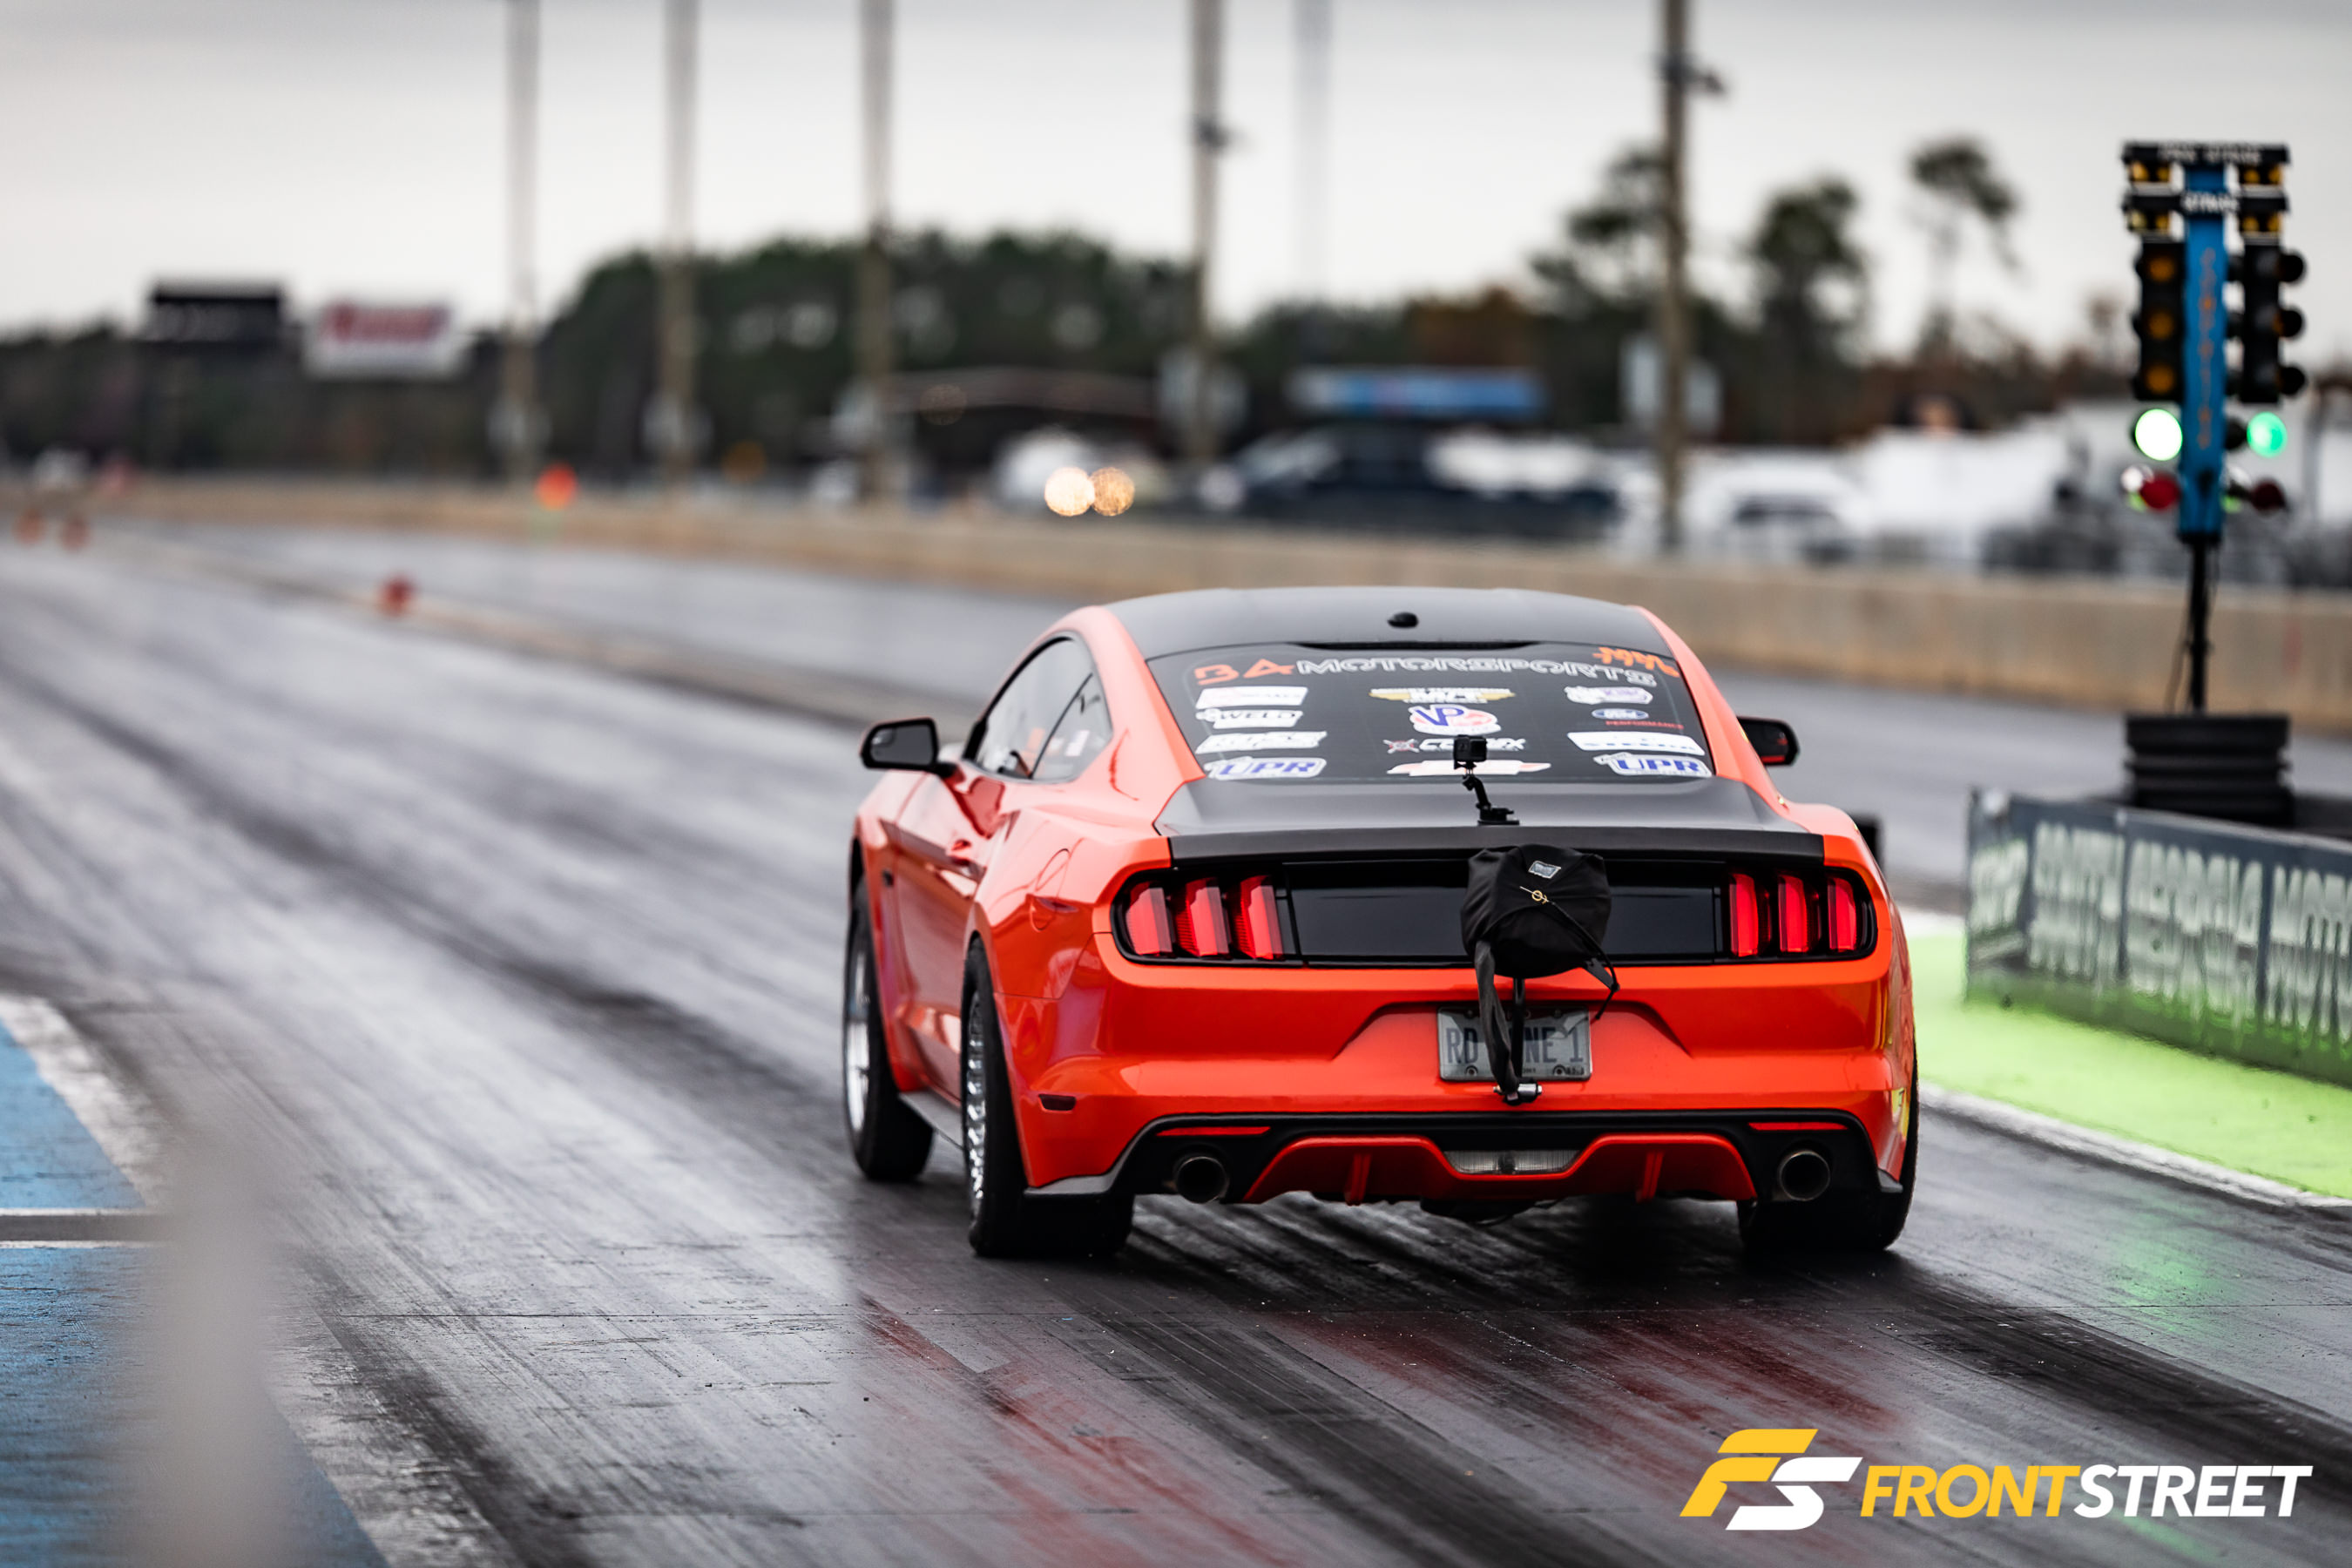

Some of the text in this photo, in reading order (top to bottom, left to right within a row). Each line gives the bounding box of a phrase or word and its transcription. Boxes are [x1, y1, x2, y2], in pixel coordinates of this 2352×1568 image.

[1296, 657, 1657, 687] MOTORSPORTS
[1415, 707, 1473, 727] VP
[1220, 761, 1316, 775] UPR
[1615, 759, 1700, 773] UPR
